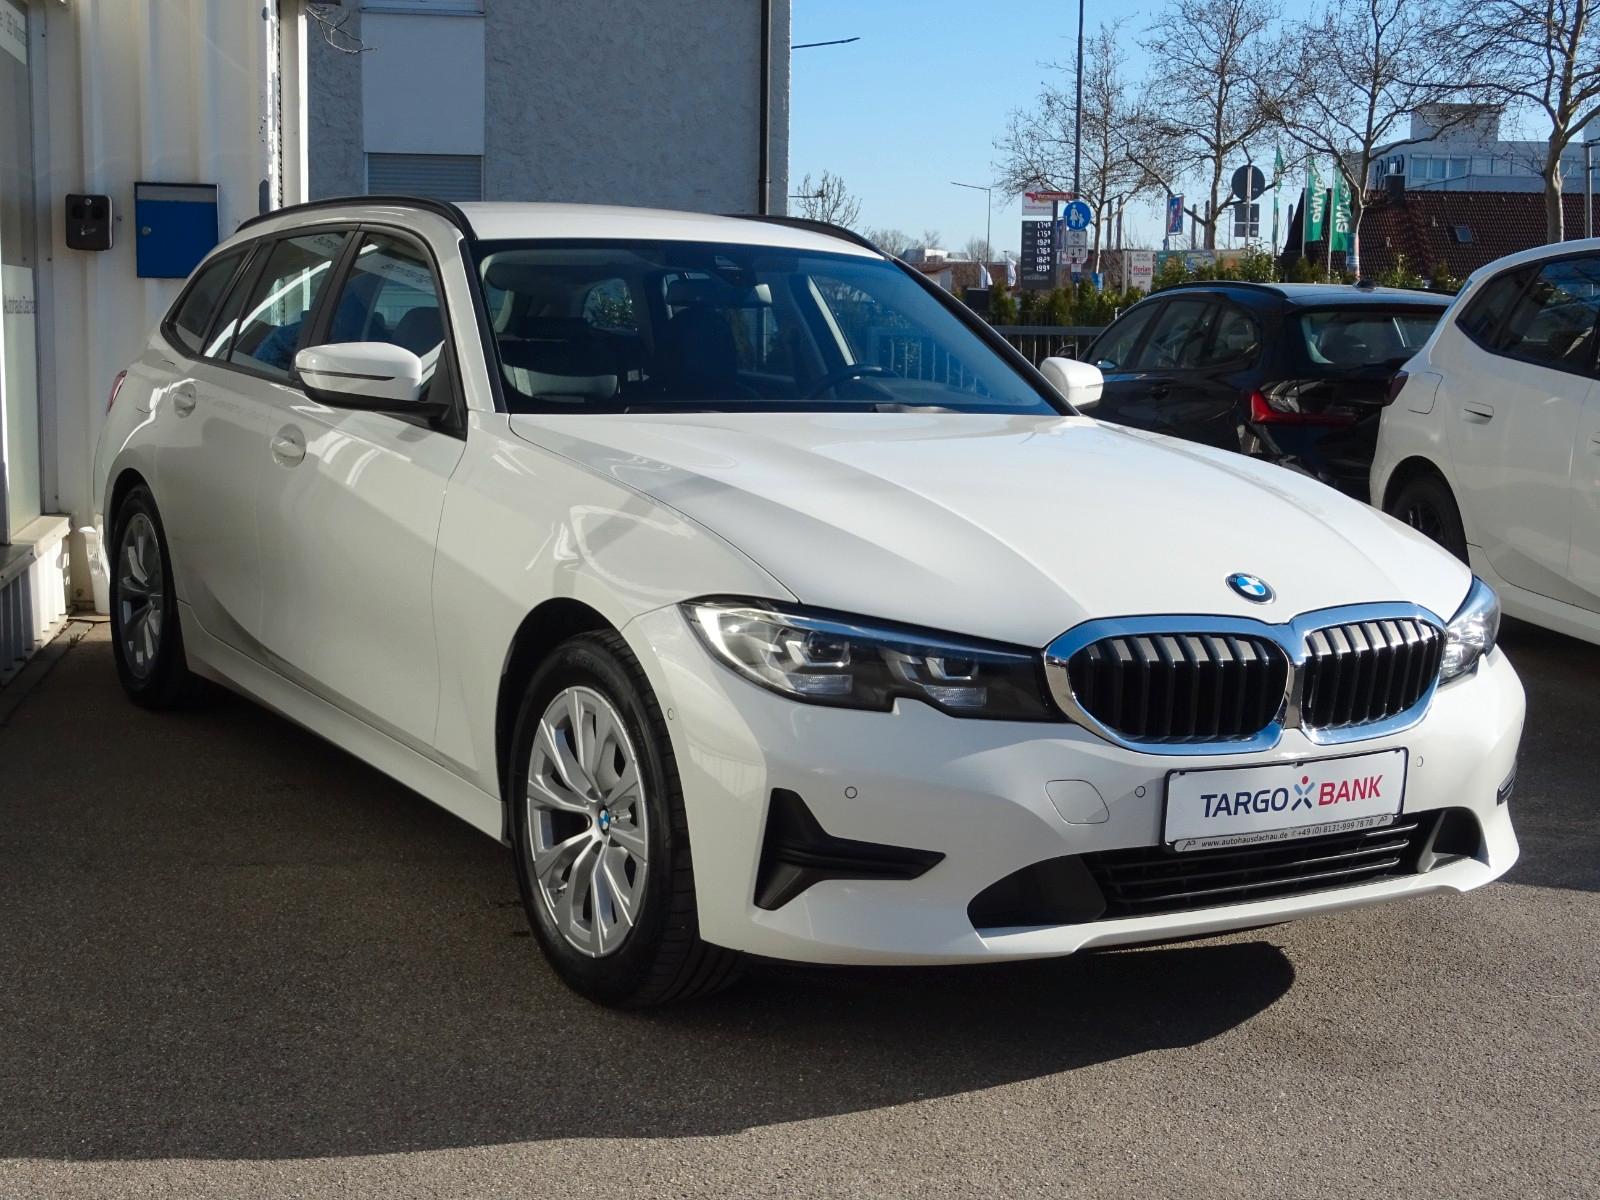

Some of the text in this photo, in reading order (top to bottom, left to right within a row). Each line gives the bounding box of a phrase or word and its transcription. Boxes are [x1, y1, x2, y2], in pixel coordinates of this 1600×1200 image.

[1200, 774, 1383, 818] TARGO BANK
[1201, 832, 1288, 847] www.autohausdachau.de
